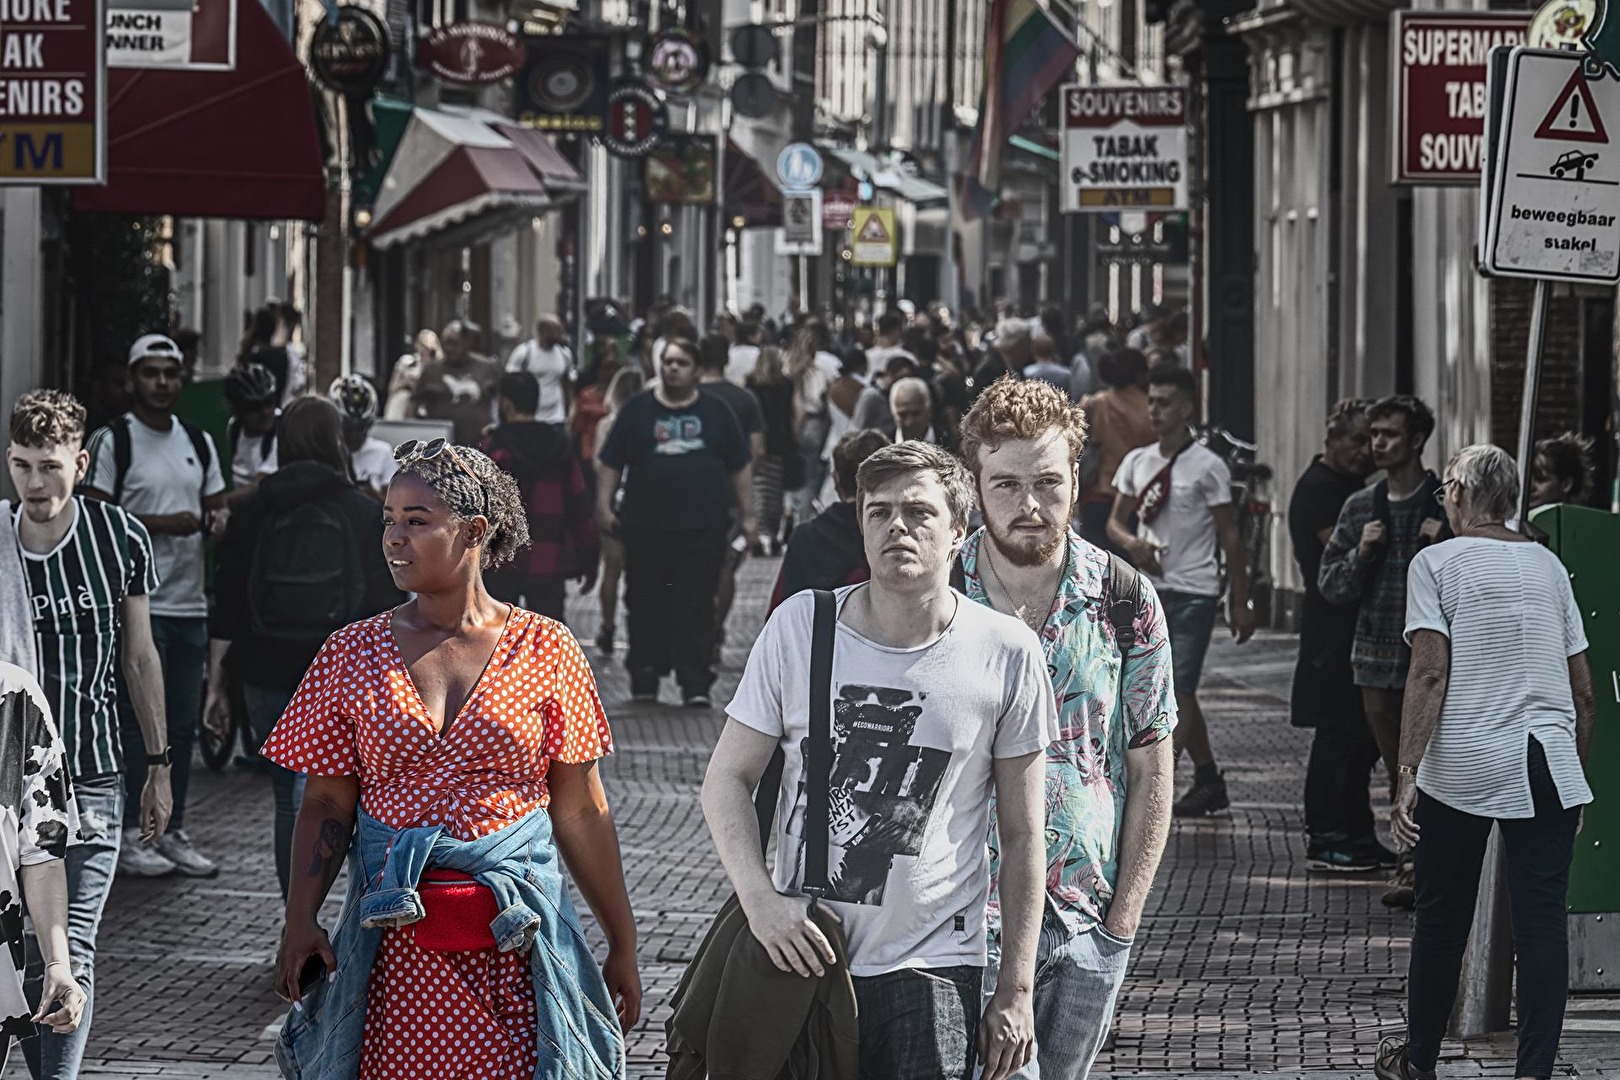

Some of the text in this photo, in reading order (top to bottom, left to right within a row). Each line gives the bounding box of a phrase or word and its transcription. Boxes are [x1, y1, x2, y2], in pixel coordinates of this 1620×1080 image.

[3, 33, 45, 68] AK
[1070, 92, 1183, 117] SOUVENIRS
[1092, 135, 1159, 158] TABAK
[1420, 133, 1484, 170] SOUV
[1071, 160, 1181, 184] e-SMOKING
[1103, 188, 1151, 206] ATM
[1511, 204, 1616, 227] beweegbaar
[852, 721, 894, 733] #ECOWARRIORS
